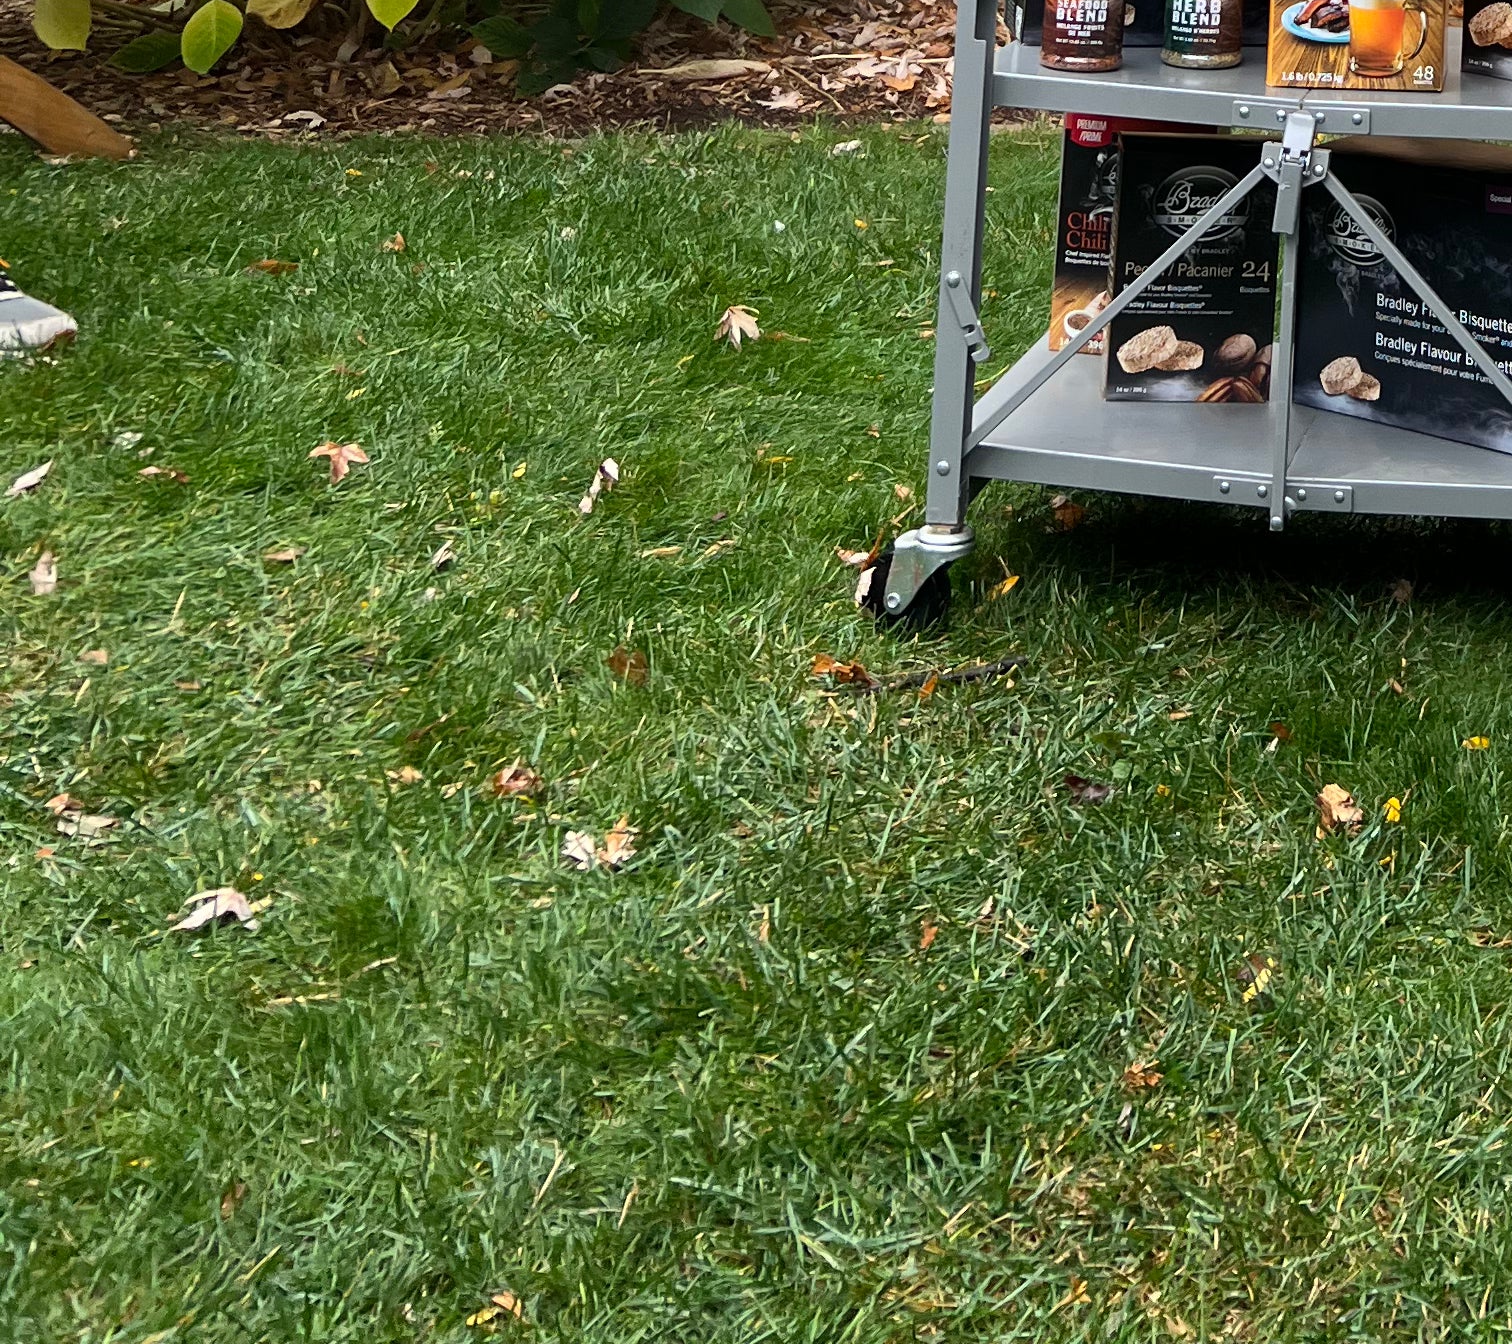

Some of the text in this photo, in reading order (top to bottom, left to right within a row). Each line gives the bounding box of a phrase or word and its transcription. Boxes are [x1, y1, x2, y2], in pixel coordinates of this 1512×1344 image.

[1056, 8, 1107, 23] BLEND
[1172, 11, 1220, 25] BLEND
[1413, 65, 1434, 80] 48
[1067, 212, 1109, 232] Chili
[1066, 230, 1107, 251] Chili
[1177, 262, 1234, 278] Pacanier
[1241, 261, 1271, 282] 24
[1376, 293, 1418, 317] Bradley
[1403, 317, 1421, 329] made
[1375, 332, 1462, 363] Bradley Flavour
